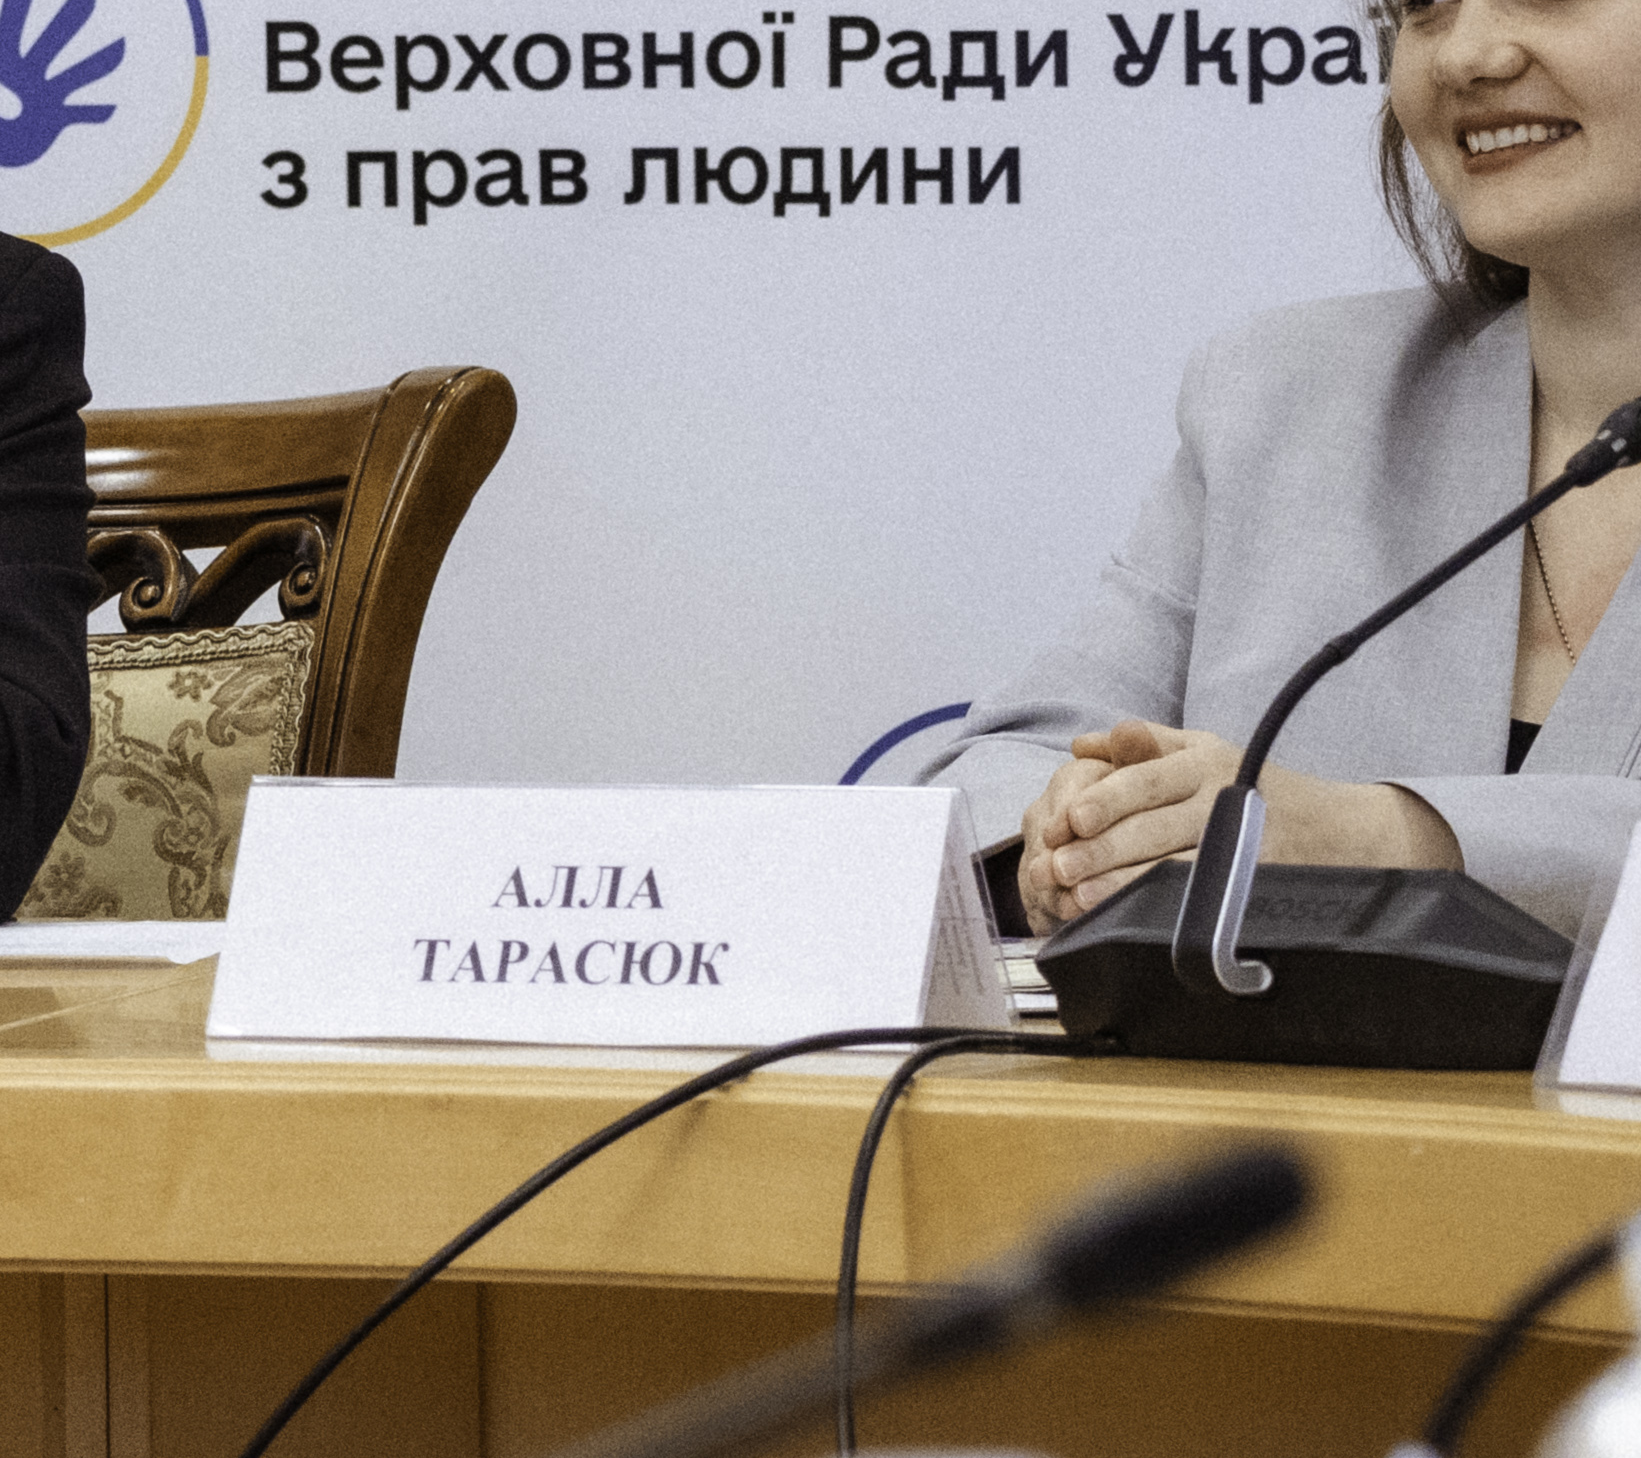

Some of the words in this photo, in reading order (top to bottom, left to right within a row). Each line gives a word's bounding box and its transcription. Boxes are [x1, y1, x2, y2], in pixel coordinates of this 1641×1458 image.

[265, 11, 795, 111] Верховної
[828, 15, 1068, 101] Ради
[262, 150, 308, 209] з
[346, 148, 588, 226] прав
[624, 146, 1021, 217] людини
[491, 864, 664, 910] АЛЛА
[414, 938, 730, 986] ТАРАСЮК
